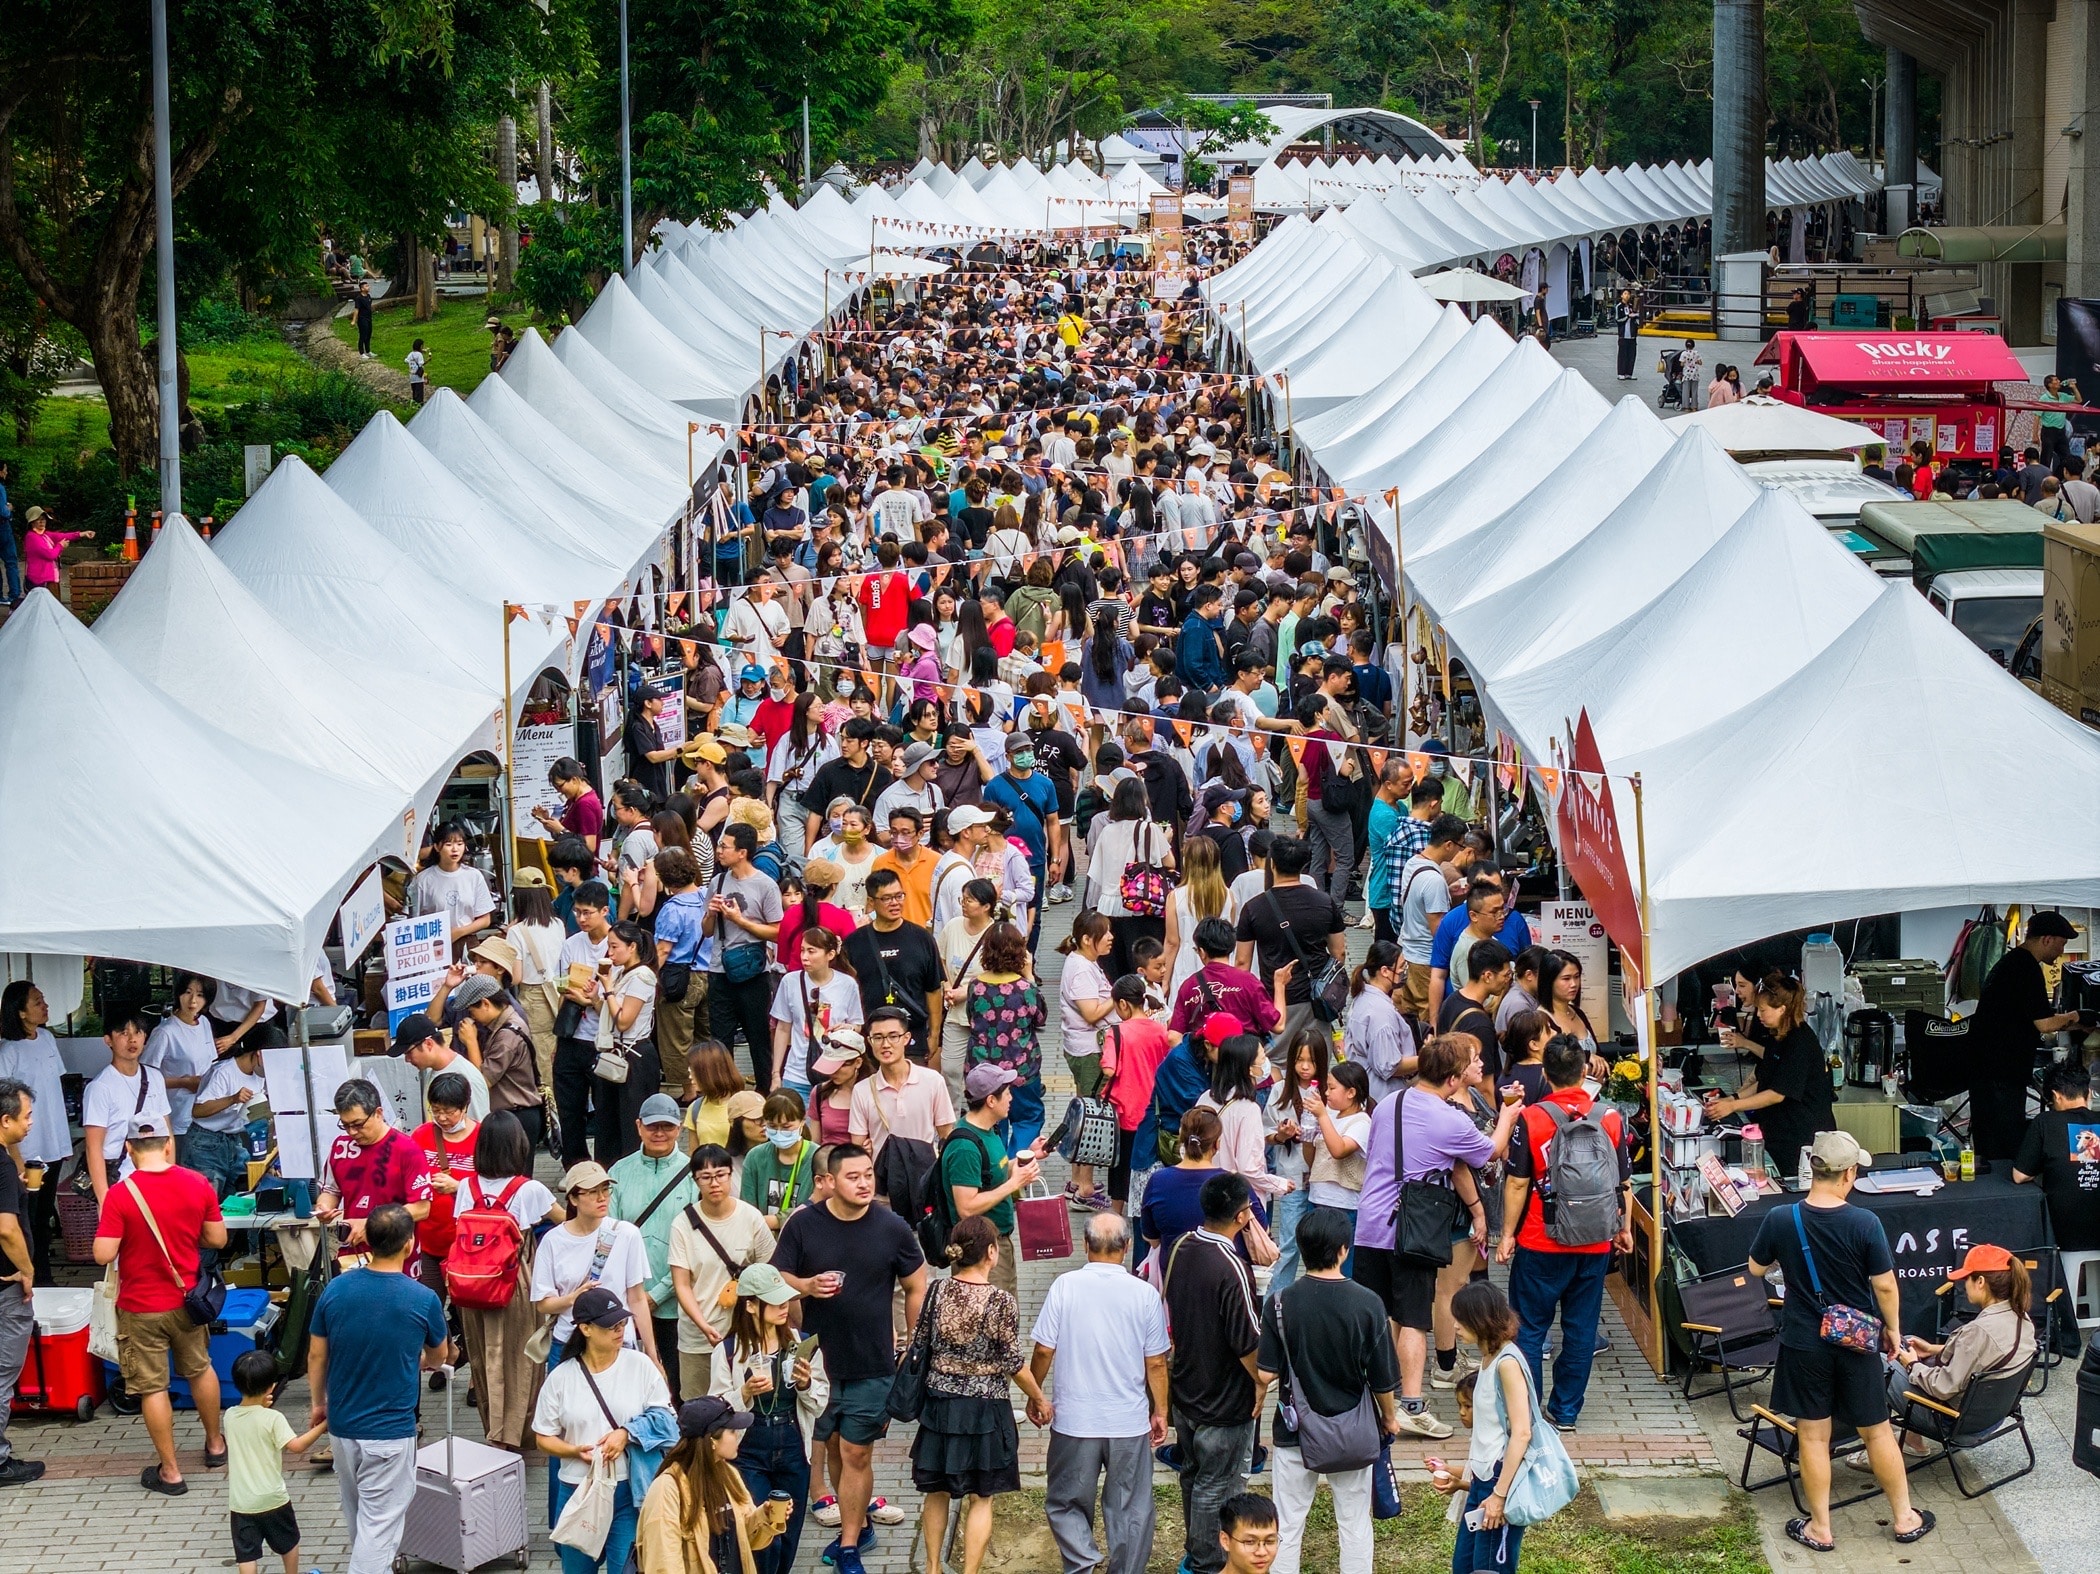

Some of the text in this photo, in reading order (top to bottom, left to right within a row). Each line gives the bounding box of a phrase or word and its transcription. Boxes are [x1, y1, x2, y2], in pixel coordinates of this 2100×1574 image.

[518, 729, 554, 741] Menu
[1554, 907, 1594, 919] MENU
[414, 919, 442, 941] 咖啡
[397, 954, 430, 969] PK100
[395, 982, 431, 1003] 掛耳包
[1929, 1022, 1960, 1032] Coleman
[1895, 1228, 1969, 1253] ASE
[1898, 1266, 1953, 1278] ROASTE
